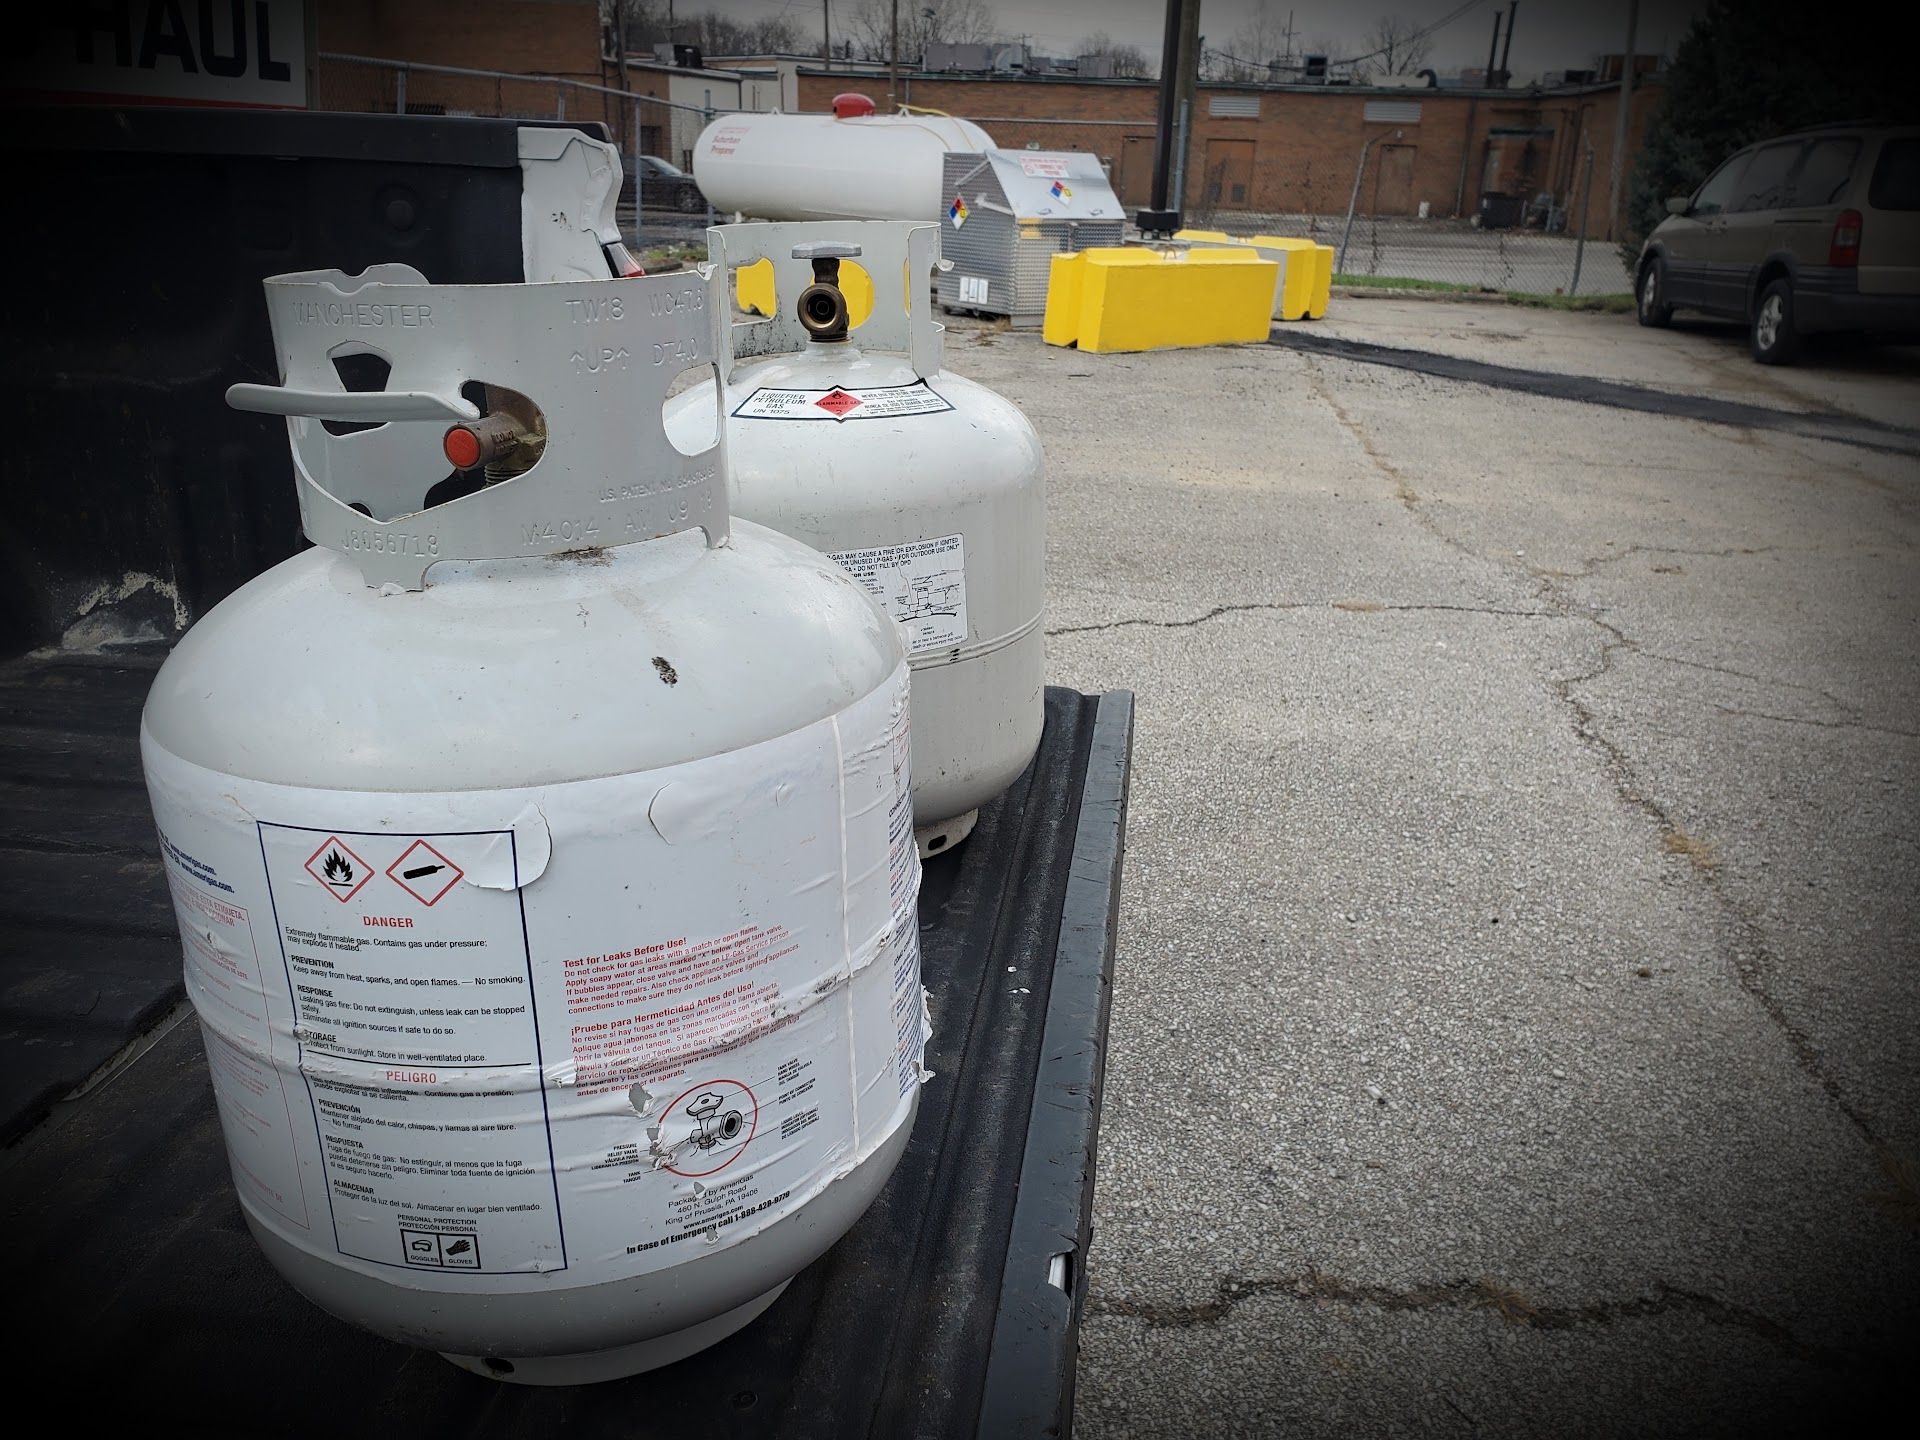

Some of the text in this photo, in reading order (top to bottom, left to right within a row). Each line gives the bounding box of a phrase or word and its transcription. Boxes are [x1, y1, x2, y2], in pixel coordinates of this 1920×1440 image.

[293, 303, 435, 328] MANCHESTER
[753, 397, 806, 405] PETROLEUM
[858, 550, 878, 559] CAUSE
[905, 543, 934, 553] EXPLOSION
[940, 537, 959, 547] IGNITED
[363, 916, 413, 928] DANGER
[285, 926, 317, 940] Extremely
[318, 932, 355, 944] flammable
[373, 938, 407, 947] Contains
[408, 941, 423, 949] gas
[424, 940, 447, 948] under
[287, 934, 301, 945] may
[302, 937, 328, 948] explode
[336, 943, 362, 952] heated.
[291, 954, 334, 969] PREVENTION
[563, 937, 687, 968] Test for Leaks Before Use!
[564, 970, 575, 978] Do
[577, 968, 590, 976] not
[591, 964, 615, 974] check
[617, 961, 628, 969] for
[629, 960, 644, 968] gas
[645, 954, 665, 964] leaks
[666, 949, 683, 959] with
[691, 940, 713, 953] match
[722, 933, 739, 943] open
[565, 977, 588, 987] Apply
[589, 974, 612, 984] soapy
[614, 969, 636, 978] water
[647, 963, 668, 972] areas
[669, 954, 697, 967] marked
[711, 945, 733, 955] below.
[734, 937, 751, 948] Open
[751, 931, 765, 941] tank
[293, 964, 526, 987] Keep away from heat, sparks, and open flames. No smoking.
[297, 984, 334, 998] RESPONSE
[299, 993, 525, 1016] Leaking gas fire: Do not extinguish, unless leak can be stopped
[301, 1004, 321, 1014] safely.
[571, 980, 754, 1036] ¡Pruebe para Hermeticidad Antes del Uso!
[302, 1012, 332, 1025] Eliminate
[333, 1018, 341, 1026] all
[342, 1019, 367, 1029] ignition
[368, 1024, 397, 1033] sources
[405, 1026, 421, 1034] safe
[422, 1026, 431, 1034] to
[432, 1026, 442, 1035] do
[330, 1044, 346, 1053] from
[347, 1047, 376, 1058] sunlight.
[377, 1050, 397, 1059] Store
[398, 1052, 405, 1060] in
[406, 1053, 461, 1062] well-ventilated
[463, 1054, 487, 1062] place.
[386, 1070, 437, 1084] PELIGRO
[318, 1098, 361, 1114] PREVENCIÓN
[325, 1134, 364, 1149] RESPUESTA
[333, 1179, 374, 1195] ALMACENAR
[668, 1174, 754, 1208] Packagd by AmeriGas
[665, 1188, 759, 1226] King of Prussia, PA 19406
[677, 1204, 692, 1214] 460
[704, 1193, 727, 1206] Gulph
[727, 1185, 747, 1196] Road
[397, 1214, 477, 1226] PERSONAL PROTECTION
[398, 1221, 440, 1231] PROTECCIÓN
[683, 1204, 744, 1230] www.amerigas.com
[626, 1246, 637, 1255] In
[637, 1241, 660, 1252] Case
[660, 1236, 670, 1246] of
[718, 1216, 733, 1228] call
[410, 1255, 439, 1263] GOGGLES
